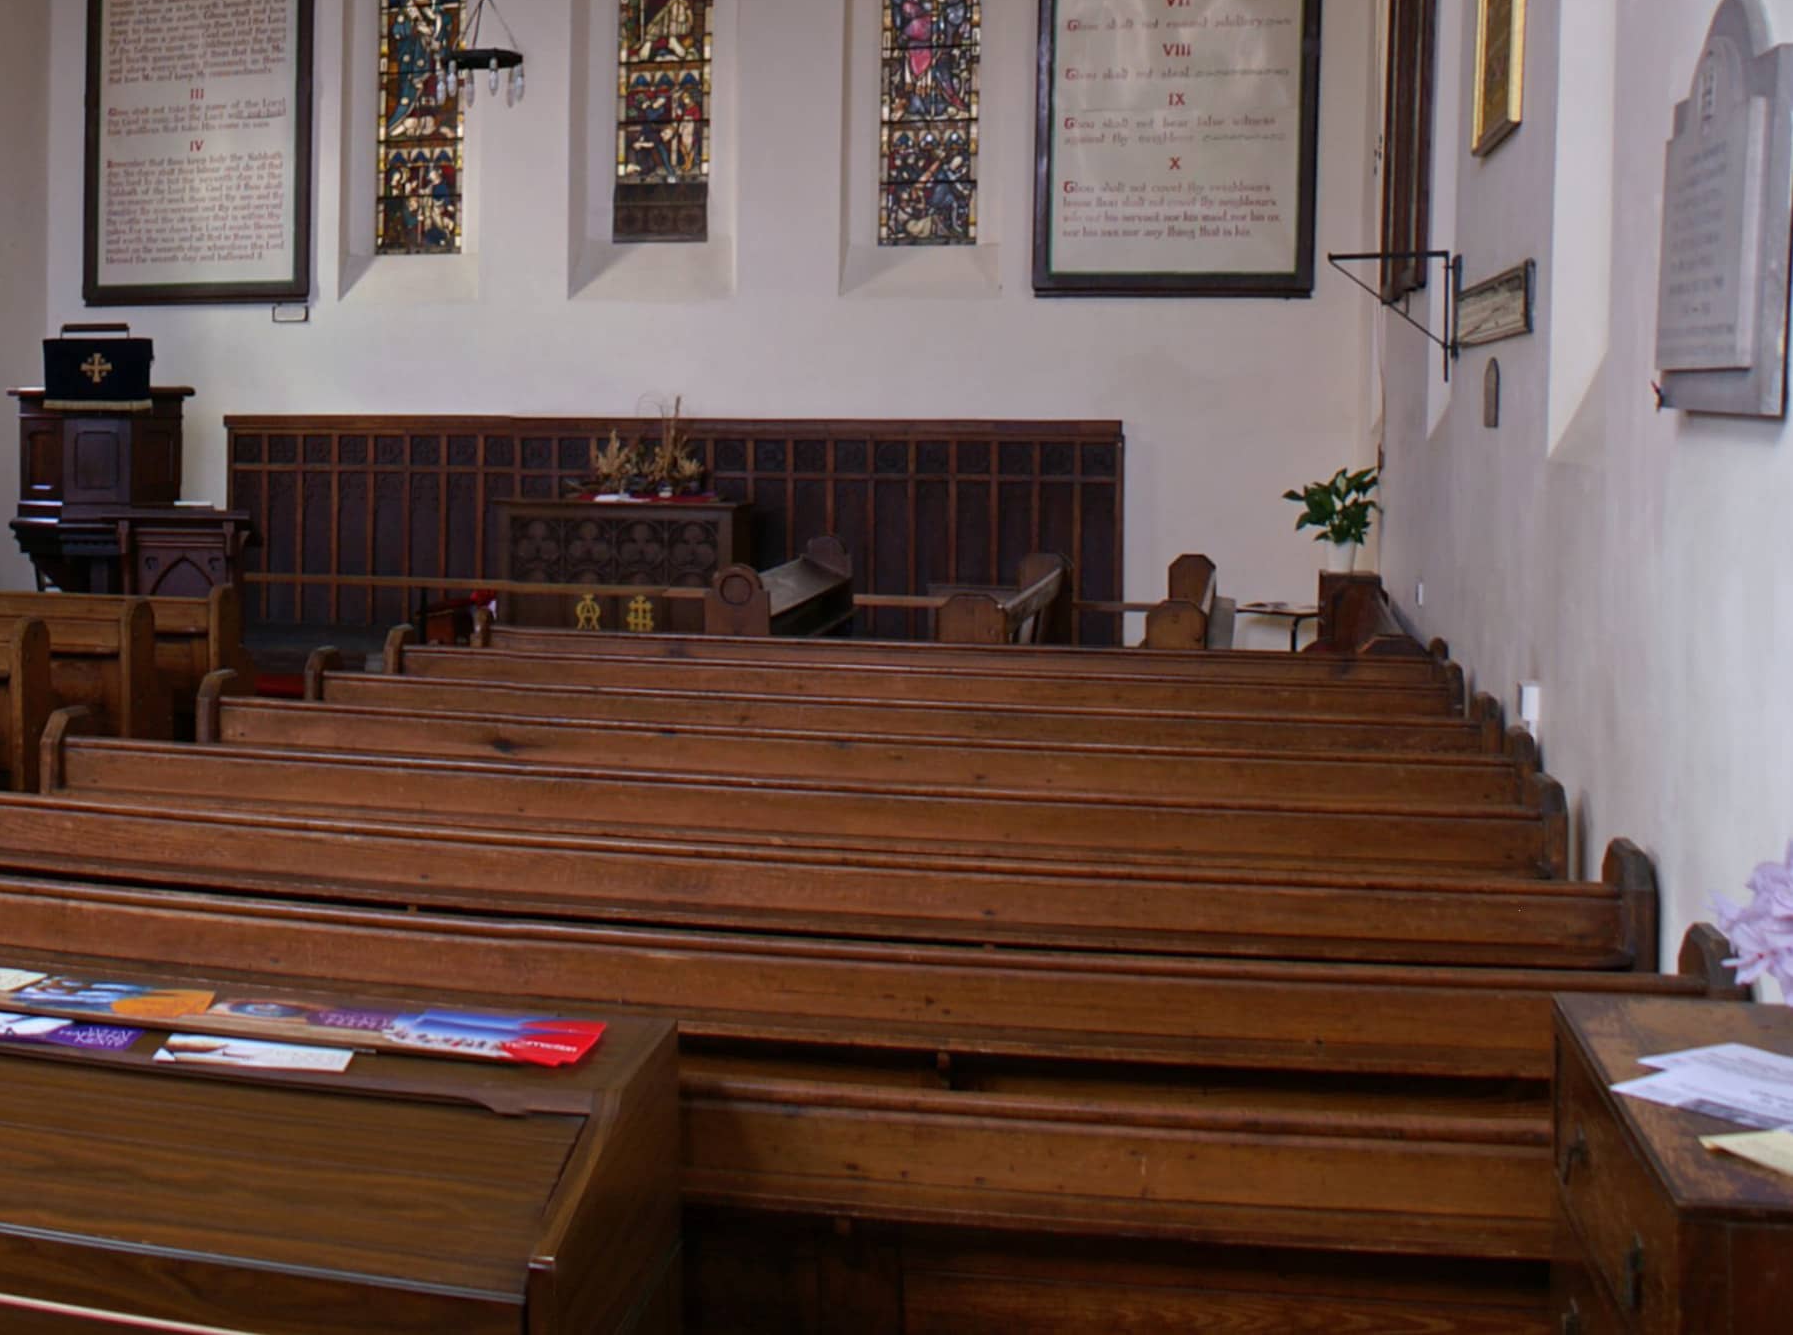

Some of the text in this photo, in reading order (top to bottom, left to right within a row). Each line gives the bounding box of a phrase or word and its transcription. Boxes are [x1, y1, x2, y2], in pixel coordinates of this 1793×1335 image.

[189, 88, 205, 100] III
[1167, 92, 1186, 107] IX
[189, 140, 204, 152] IV
[1169, 156, 1182, 171] X
